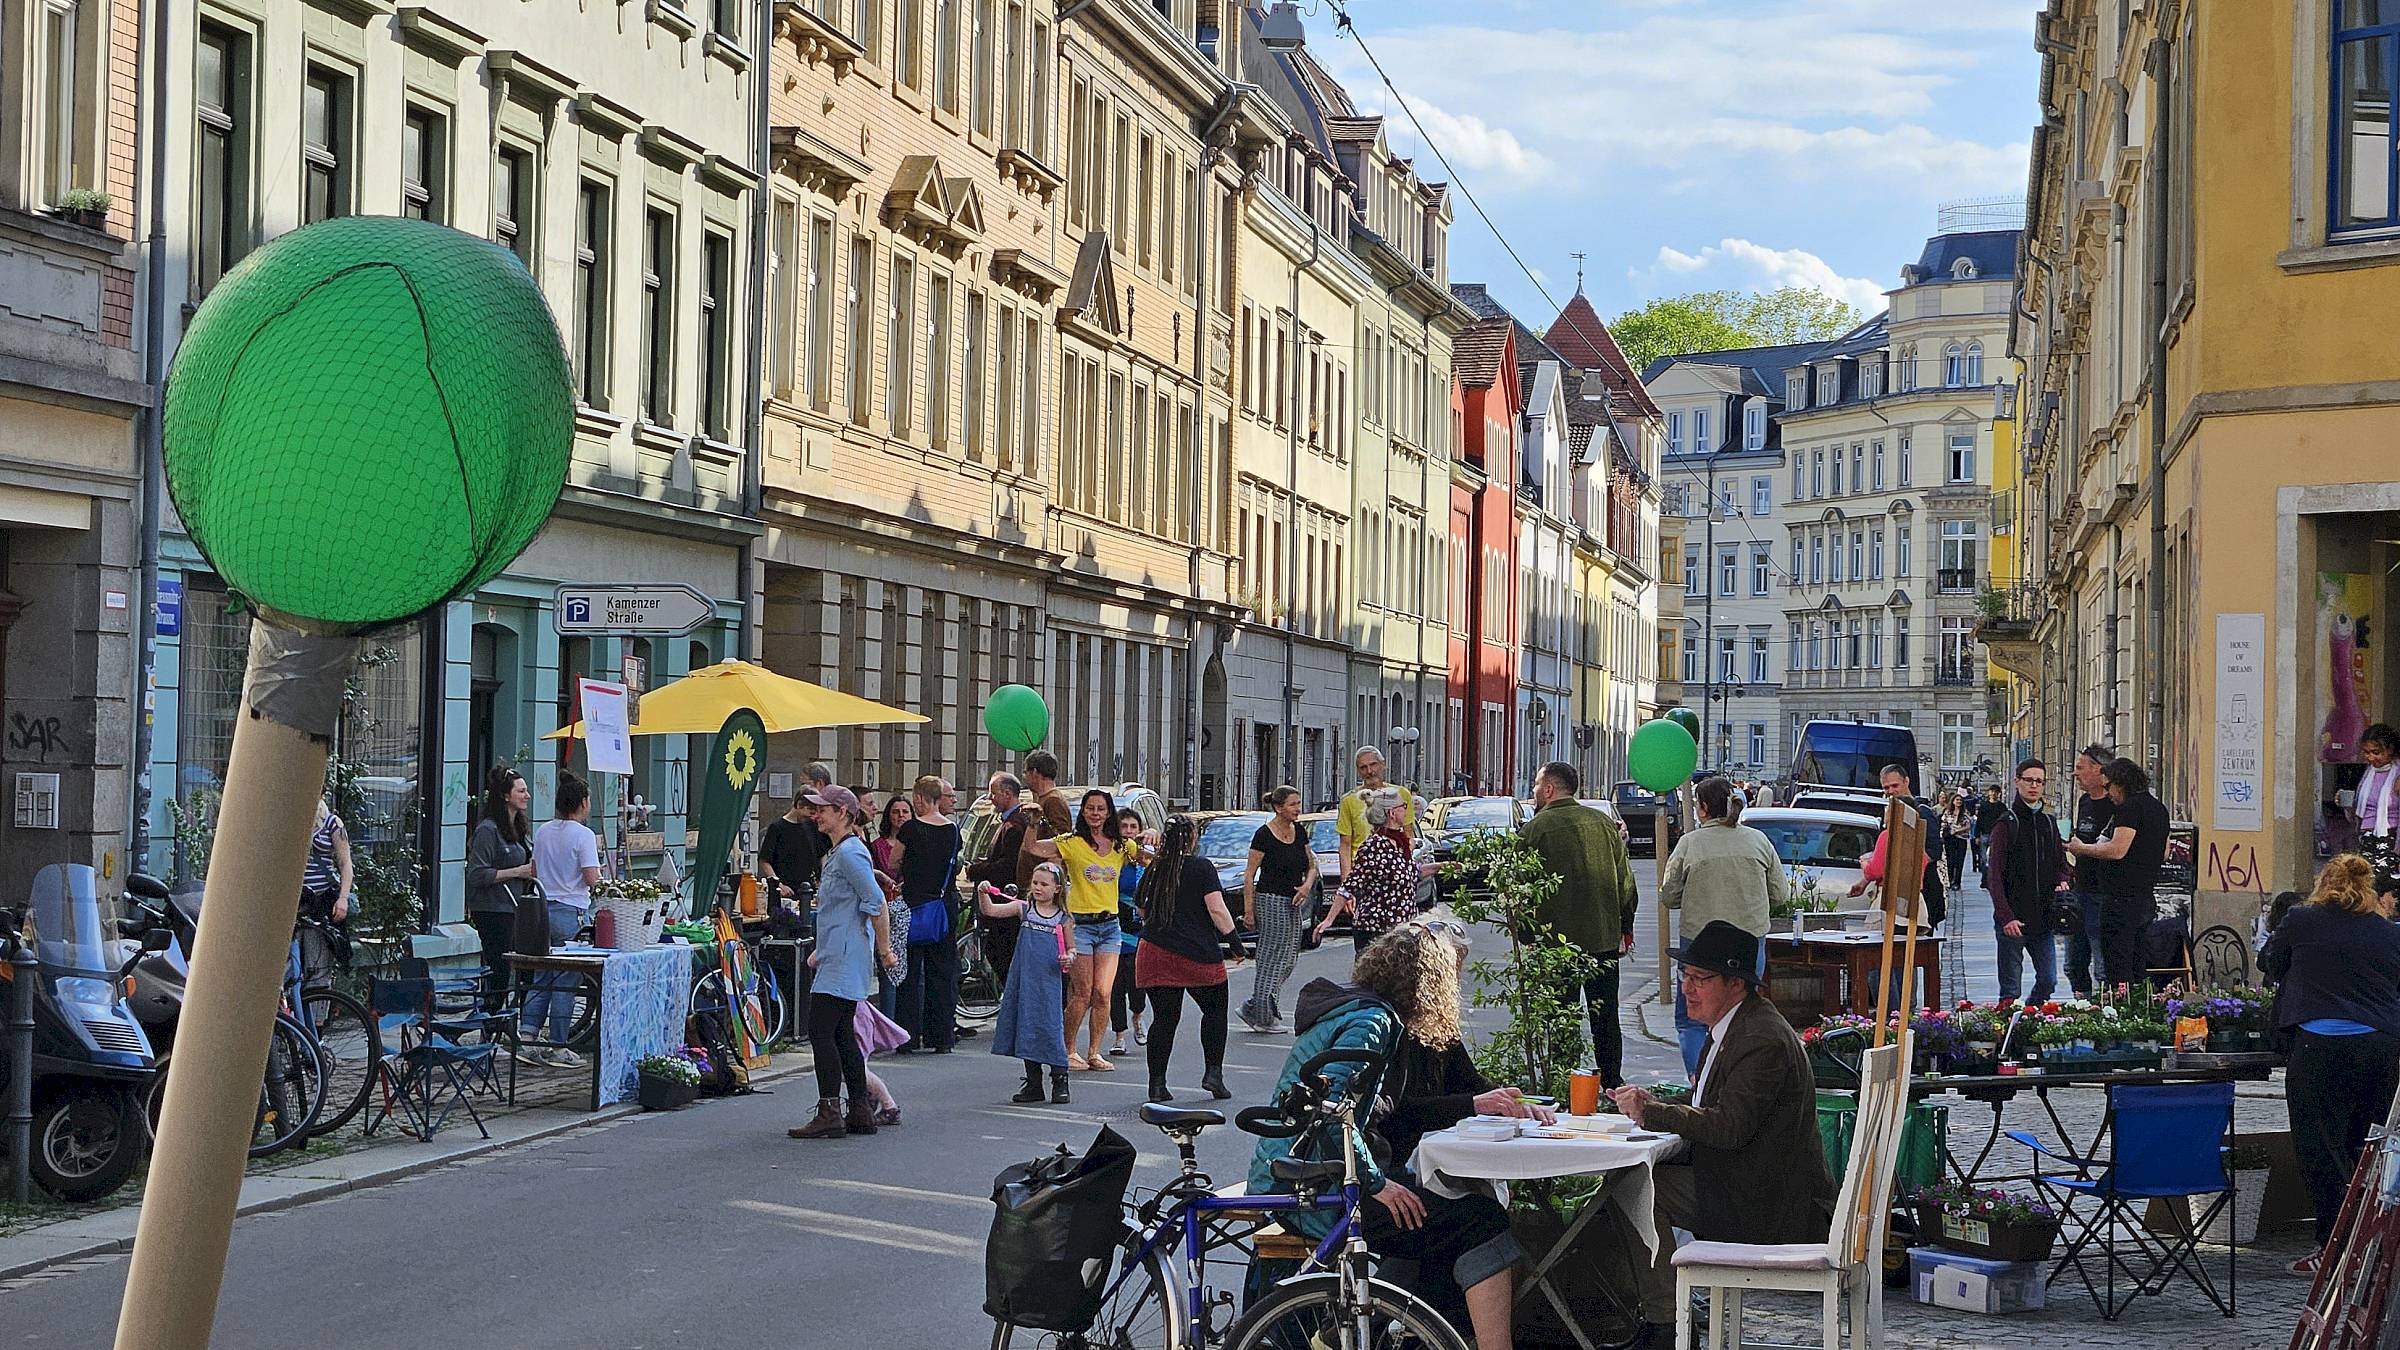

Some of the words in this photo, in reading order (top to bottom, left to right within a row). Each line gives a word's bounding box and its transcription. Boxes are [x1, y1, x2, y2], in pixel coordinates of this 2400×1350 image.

[607, 596, 660, 609] Kamenzer
[607, 612, 644, 624] Straße
[2229, 641, 2250, 649] HOUSE
[2235, 653, 2245, 661] OF
[2227, 665, 2253, 673] DREAMS
[2221, 757, 2256, 771] ZENTRUM
